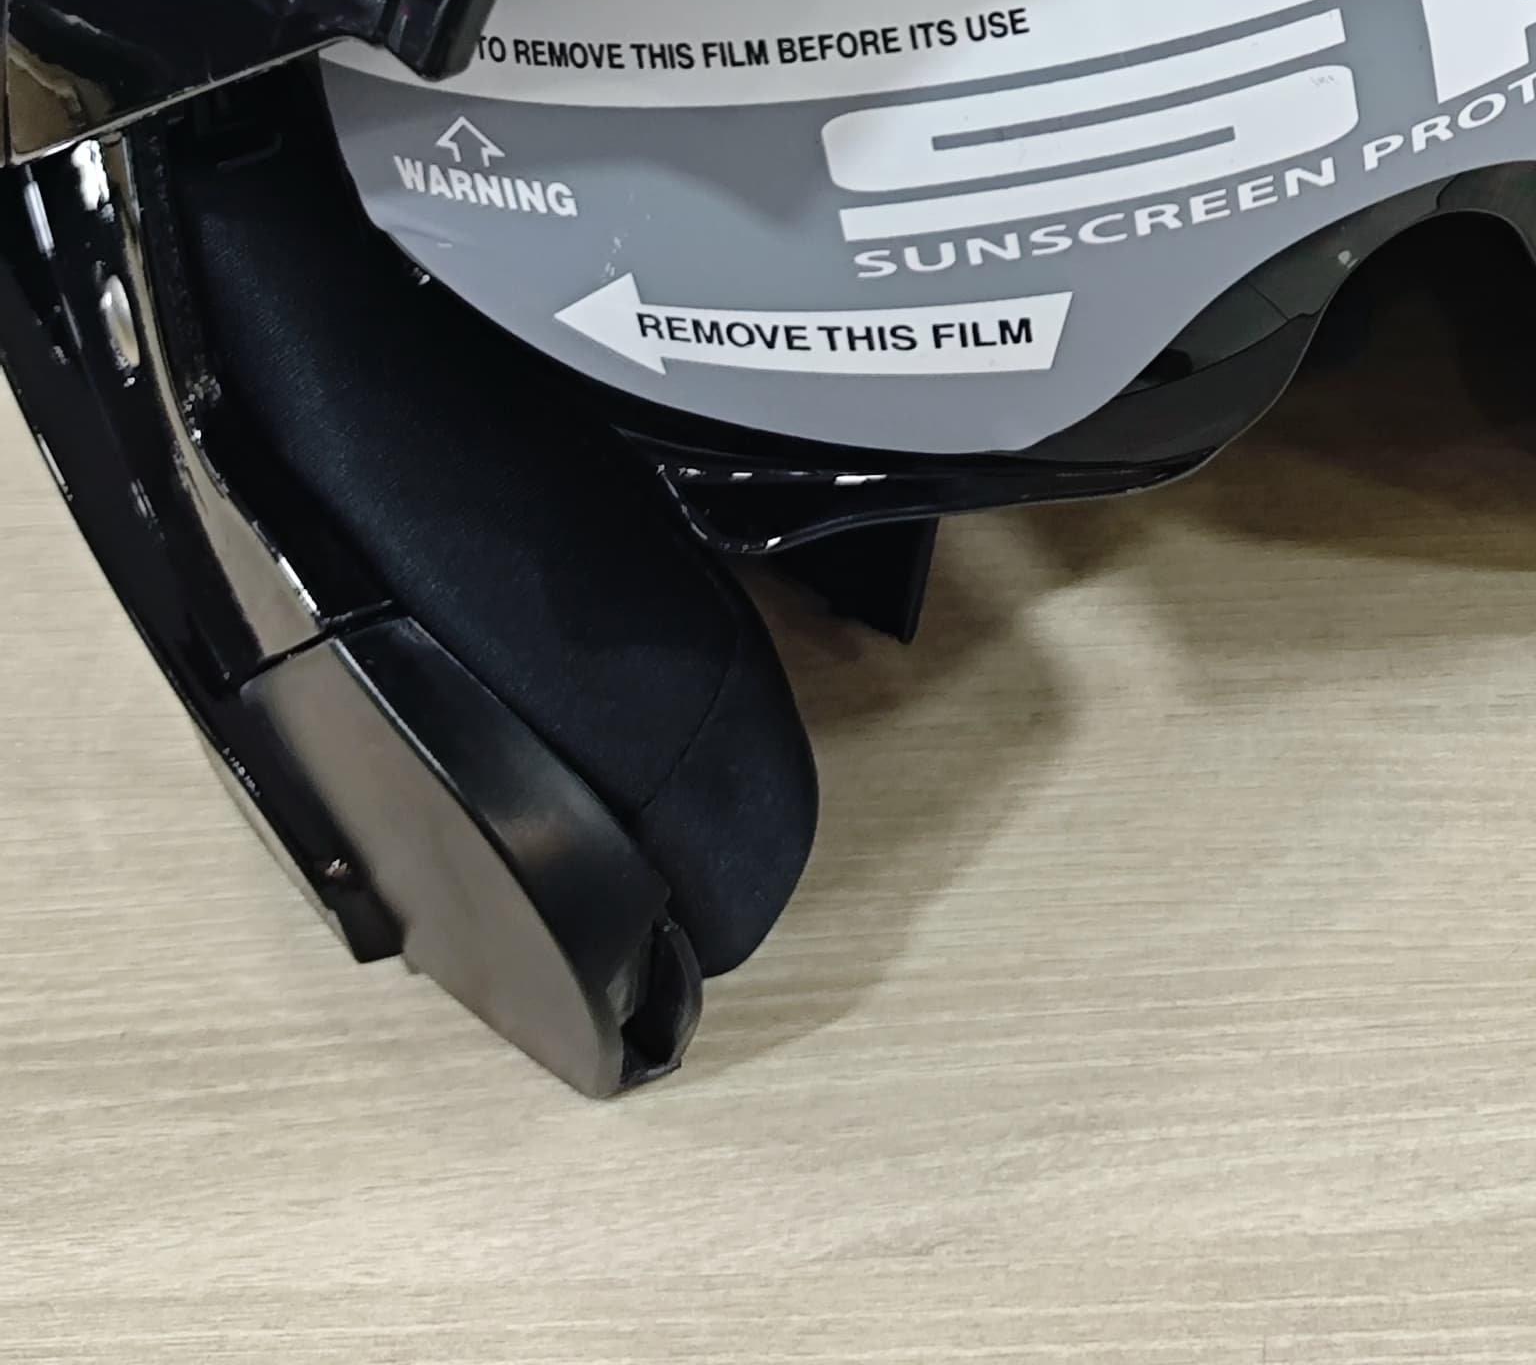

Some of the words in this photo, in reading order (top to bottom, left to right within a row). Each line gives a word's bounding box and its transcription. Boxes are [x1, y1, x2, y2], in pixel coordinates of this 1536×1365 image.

[513, 38, 626, 70] REMOVE
[629, 43, 696, 70] THIS
[702, 39, 771, 68] FILM
[776, 26, 902, 66] BEFORE
[908, 19, 958, 52] ITS
[965, 7, 1031, 42] USE
[392, 154, 579, 218] WARNING
[854, 158, 1337, 279] SUNSCREEN
[636, 312, 812, 351] REMOVE
[816, 325, 918, 351] THIS
[931, 317, 1033, 350] FILM
